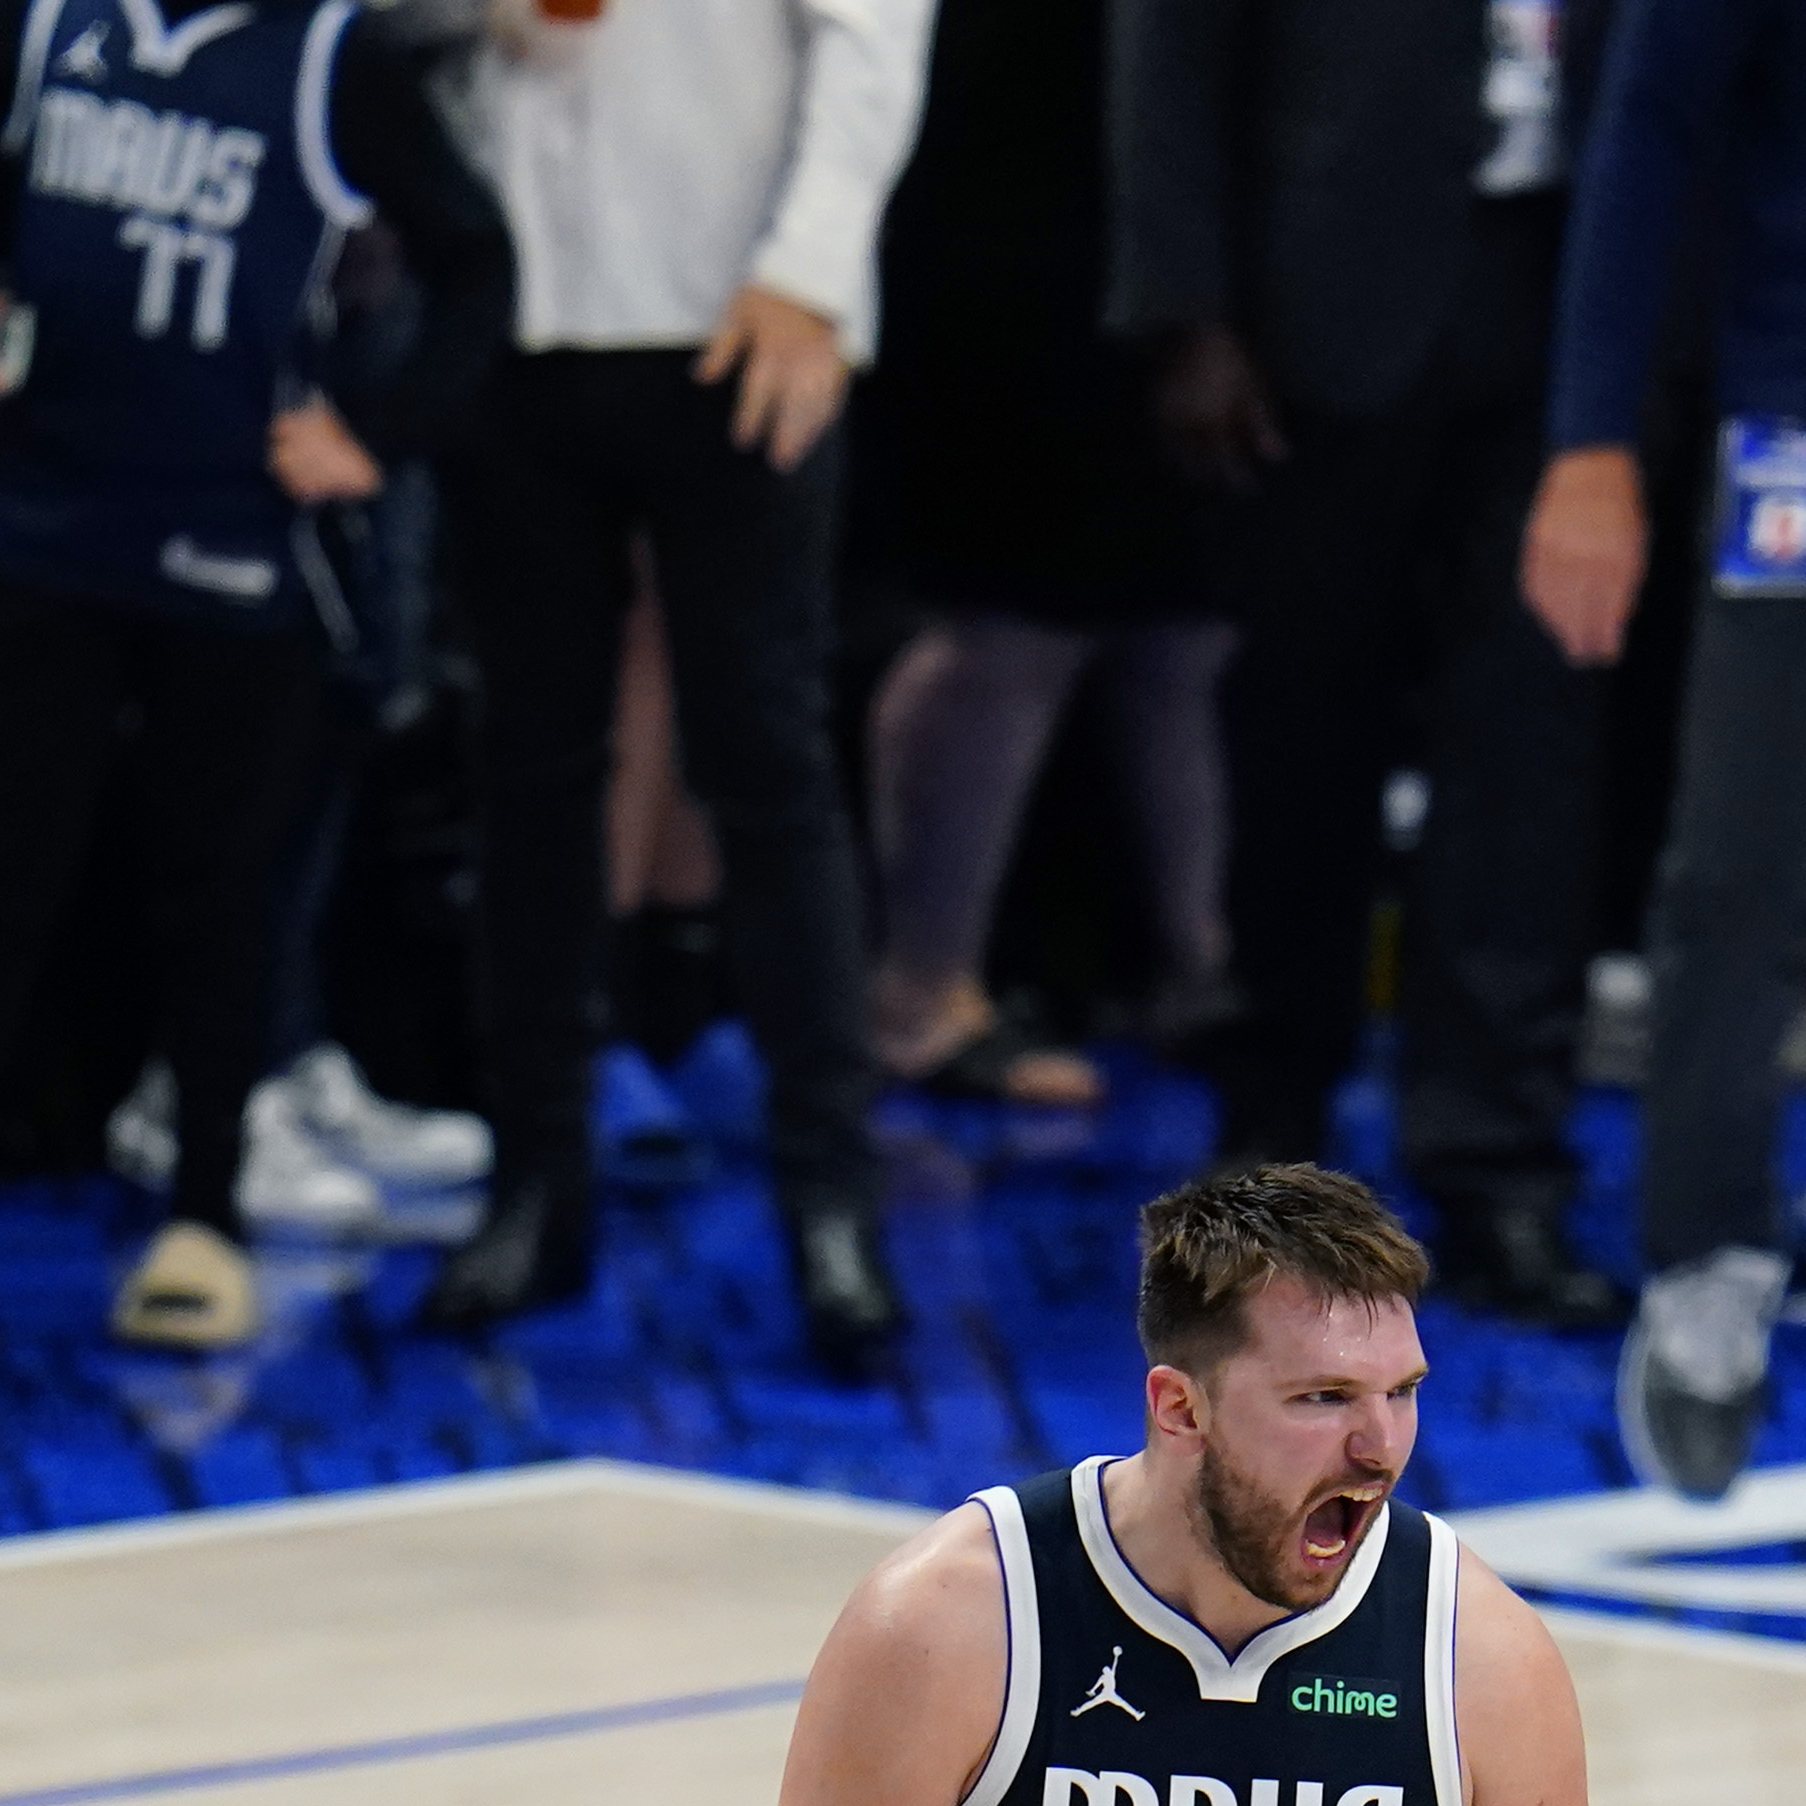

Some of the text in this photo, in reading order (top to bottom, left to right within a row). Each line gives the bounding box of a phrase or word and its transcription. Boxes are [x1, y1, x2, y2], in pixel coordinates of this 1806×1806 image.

[30, 87, 265, 232] MAVS
[117, 213, 235, 352] 77
[1292, 1678, 1398, 1719] chime
